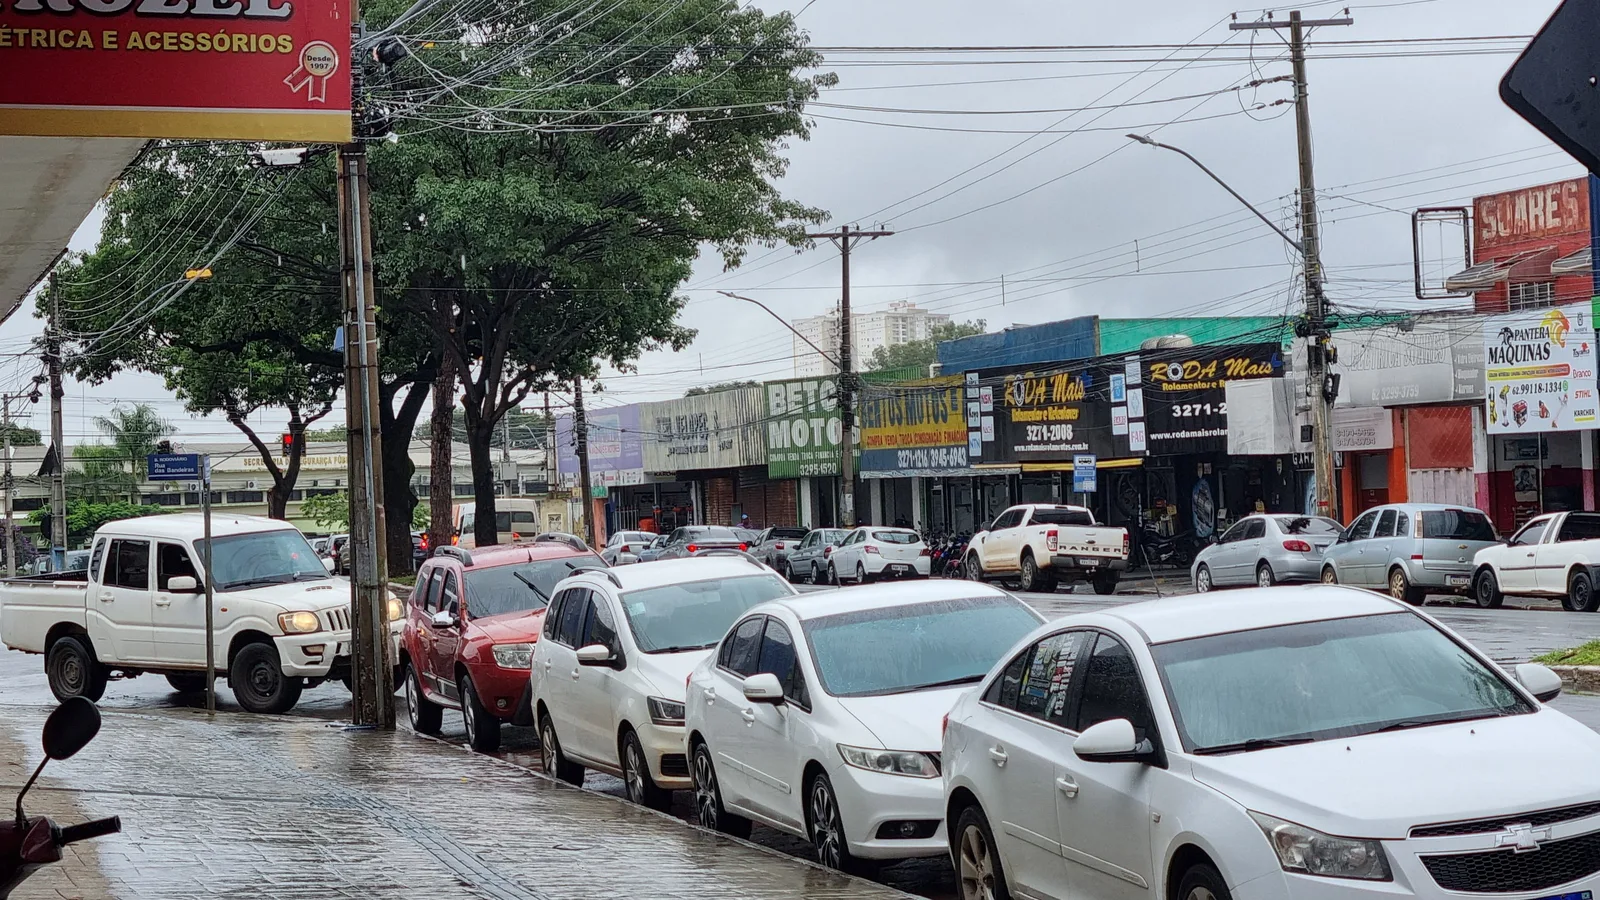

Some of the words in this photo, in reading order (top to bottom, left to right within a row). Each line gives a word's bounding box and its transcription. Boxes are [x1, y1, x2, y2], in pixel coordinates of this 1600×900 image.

[103, 30, 118, 49] E
[127, 29, 293, 53] ACESSÓRIOS
[1480, 182, 1579, 240] SOARES
[1514, 326, 1550, 341] PANTERA
[1488, 342, 1551, 365] MAQUINAS
[1224, 358, 1273, 376] Mais
[1573, 369, 1591, 378] Branco
[1050, 373, 1085, 402] Mais
[1162, 382, 1209, 391] Rolamentos
[1574, 390, 1592, 399] STIHL
[1172, 402, 1228, 417] 3271-2
[1026, 424, 1073, 441] 3271-2008
[1060, 545, 1122, 553] RANGER
